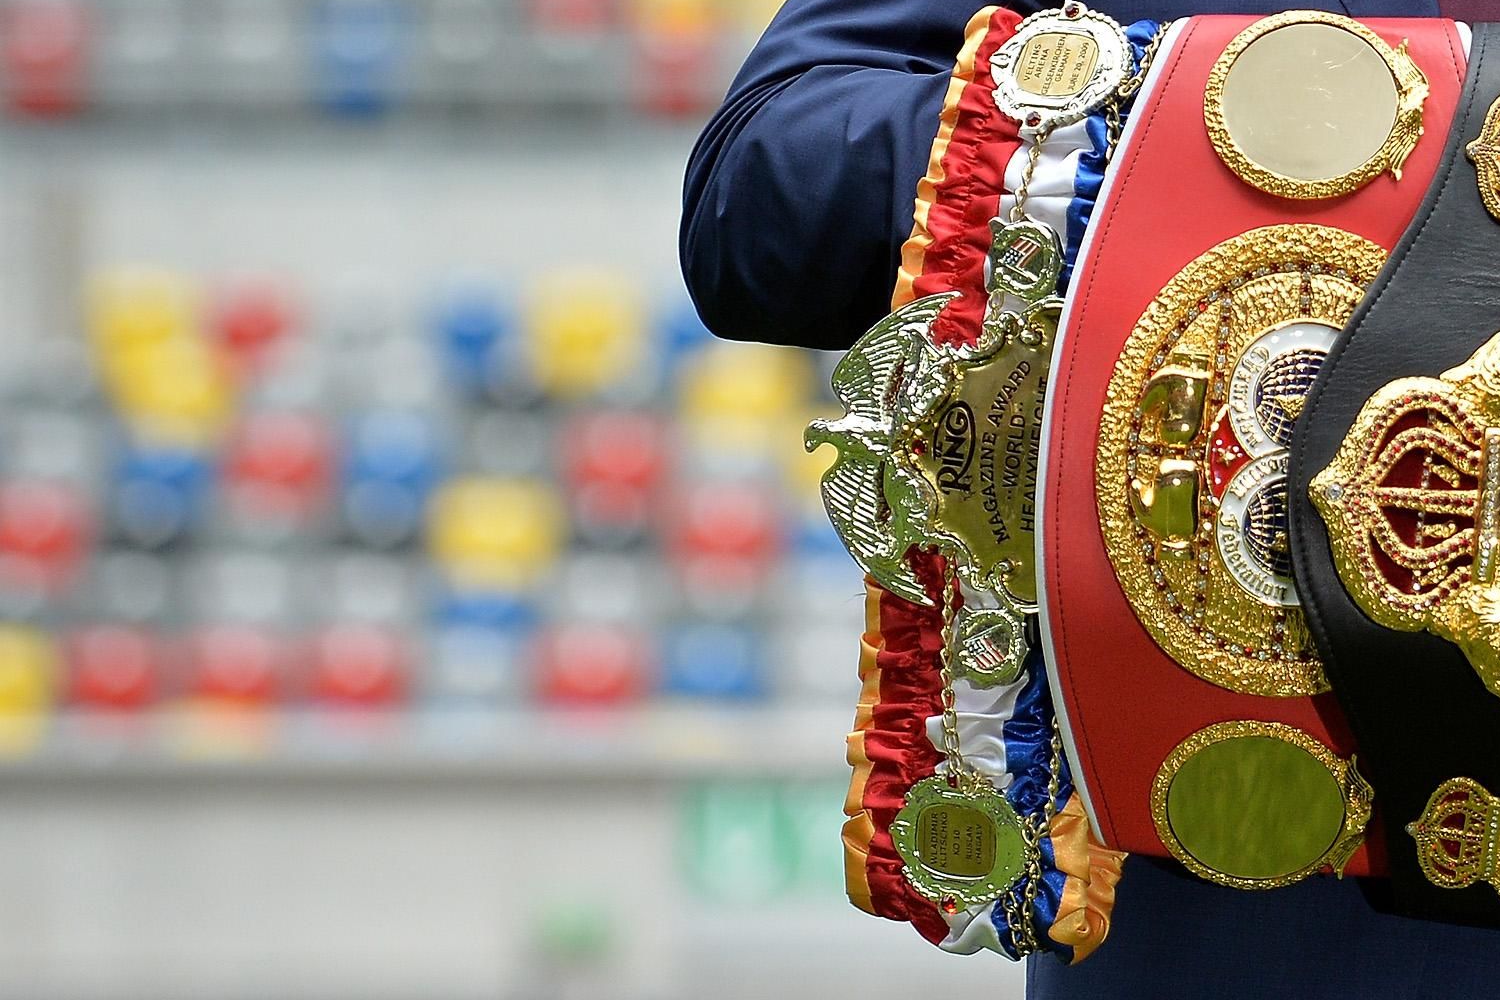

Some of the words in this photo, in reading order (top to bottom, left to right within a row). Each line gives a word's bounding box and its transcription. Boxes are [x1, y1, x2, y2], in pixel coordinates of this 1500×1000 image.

[1024, 43, 1042, 81] VELTINS
[1034, 48, 1049, 79] ARENA
[1041, 36, 1066, 96] GELSENKIRCHEN
[1055, 48, 1071, 82] GERMANY
[1068, 73, 1079, 91] JUNE
[987, 360, 1031, 428] AWARD
[936, 406, 973, 496] RING
[979, 431, 1011, 544] MAGAZINE
[1219, 510, 1287, 601] Federation
[939, 811, 948, 868] KLITSCHKO
